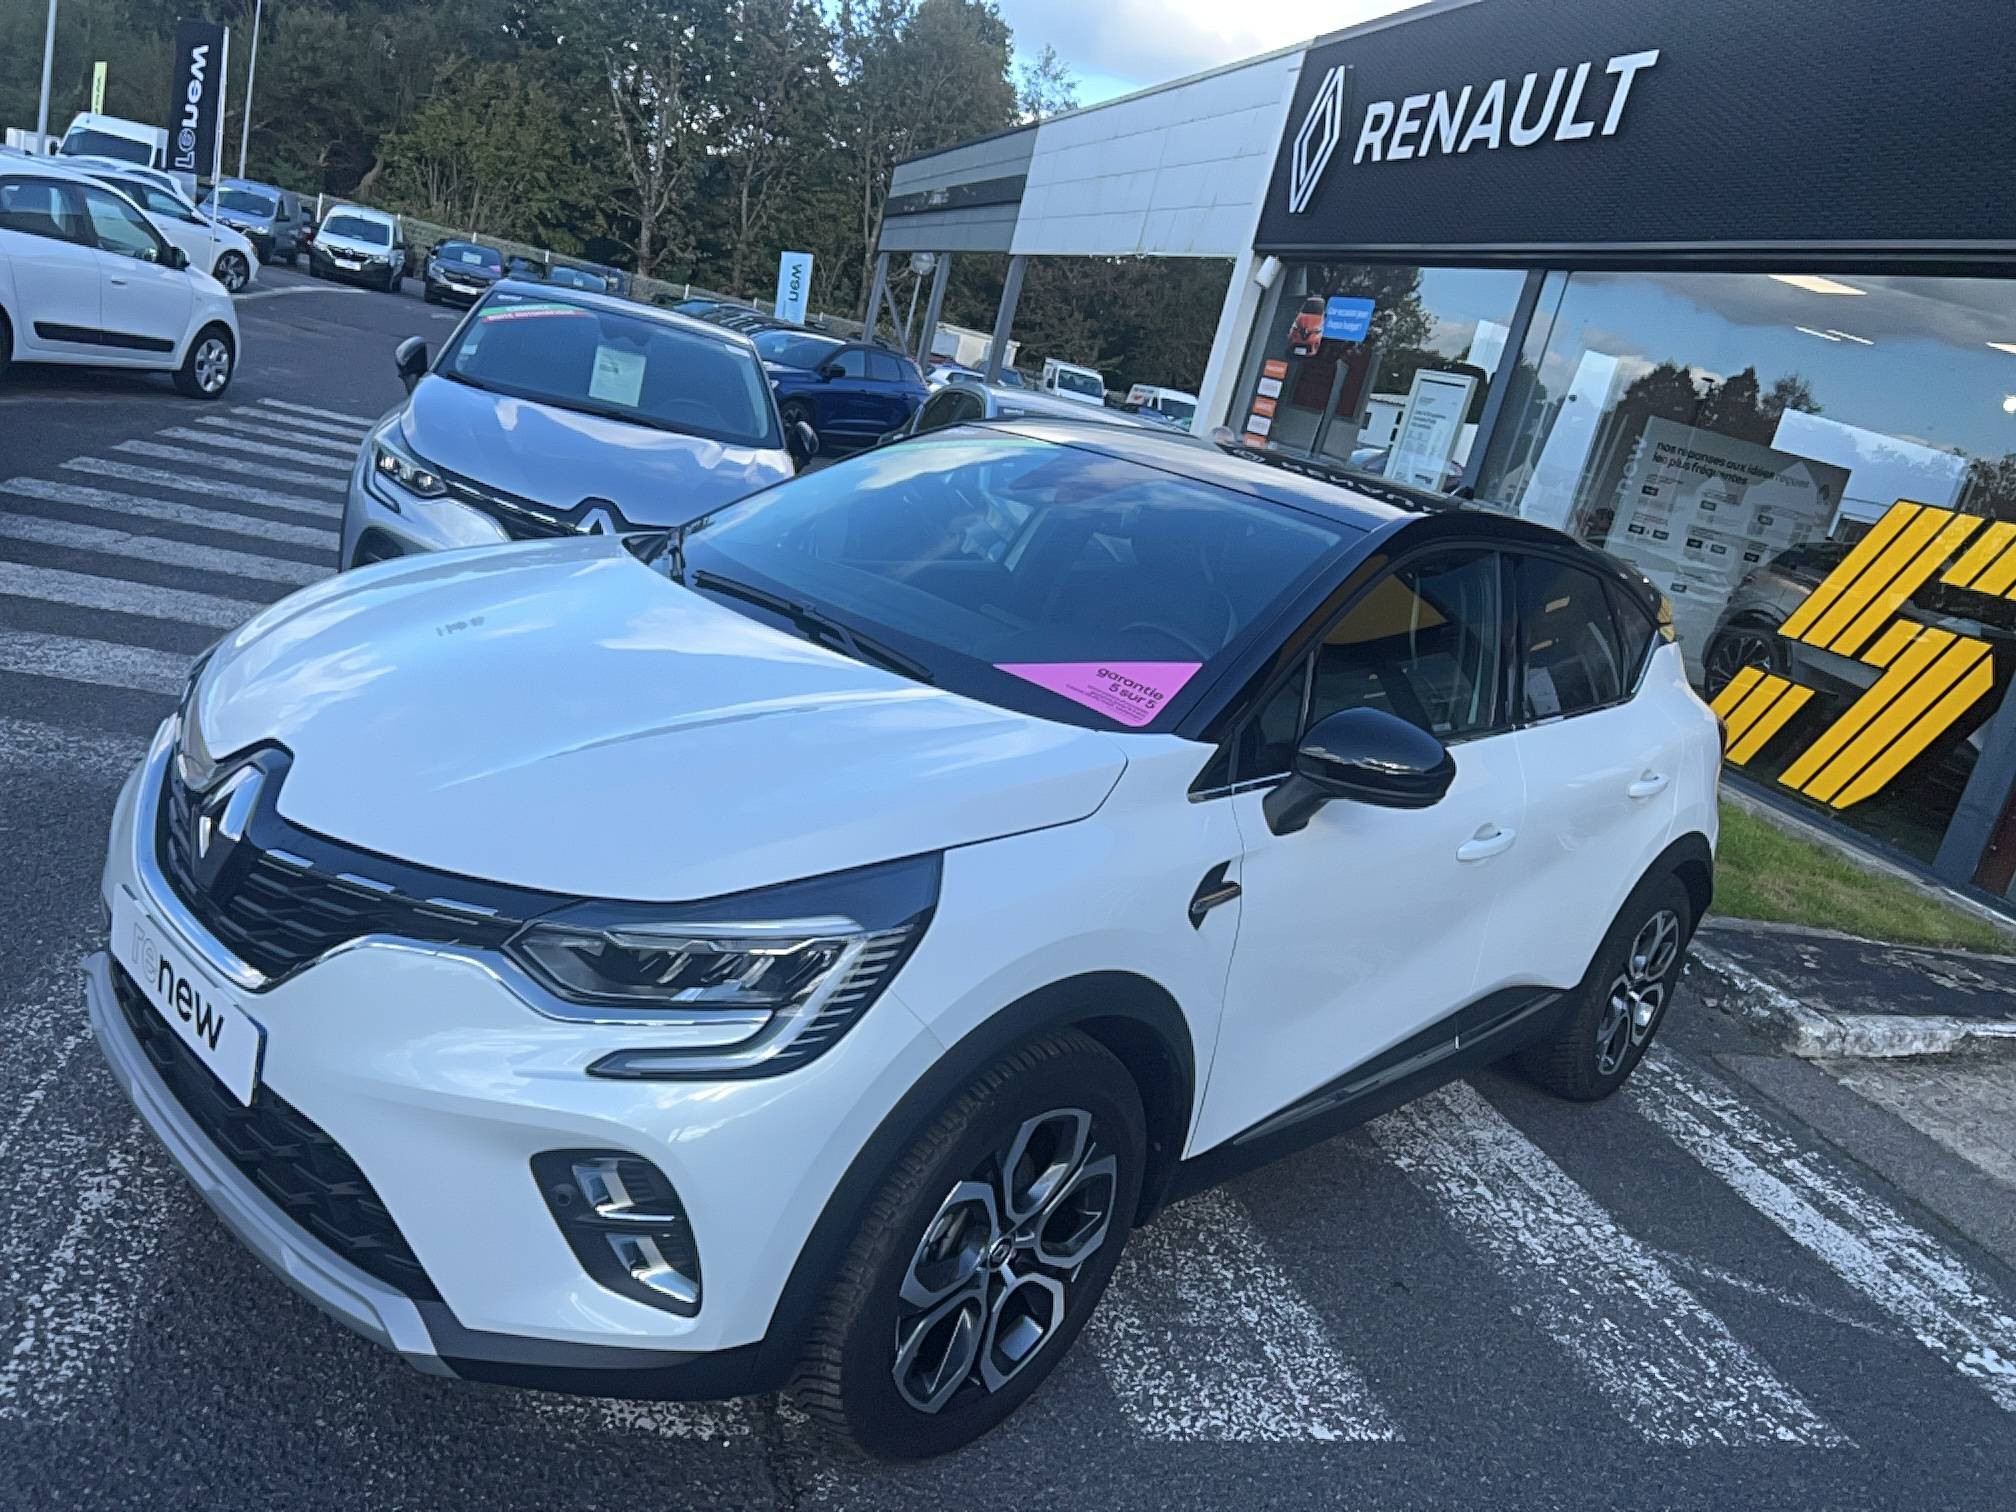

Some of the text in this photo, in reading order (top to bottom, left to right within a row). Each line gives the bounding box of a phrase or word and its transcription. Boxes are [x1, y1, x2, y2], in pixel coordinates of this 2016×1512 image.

[175, 44, 210, 169] renew
[1352, 49, 1661, 165] RENAULT
[1657, 441, 1677, 454] nos
[1726, 460, 1746, 473] aux
[1667, 457, 1691, 471] plus
[1095, 668, 1164, 700] garantie
[1108, 682, 1158, 709] 5 sur 5
[130, 921, 225, 1052] renew
